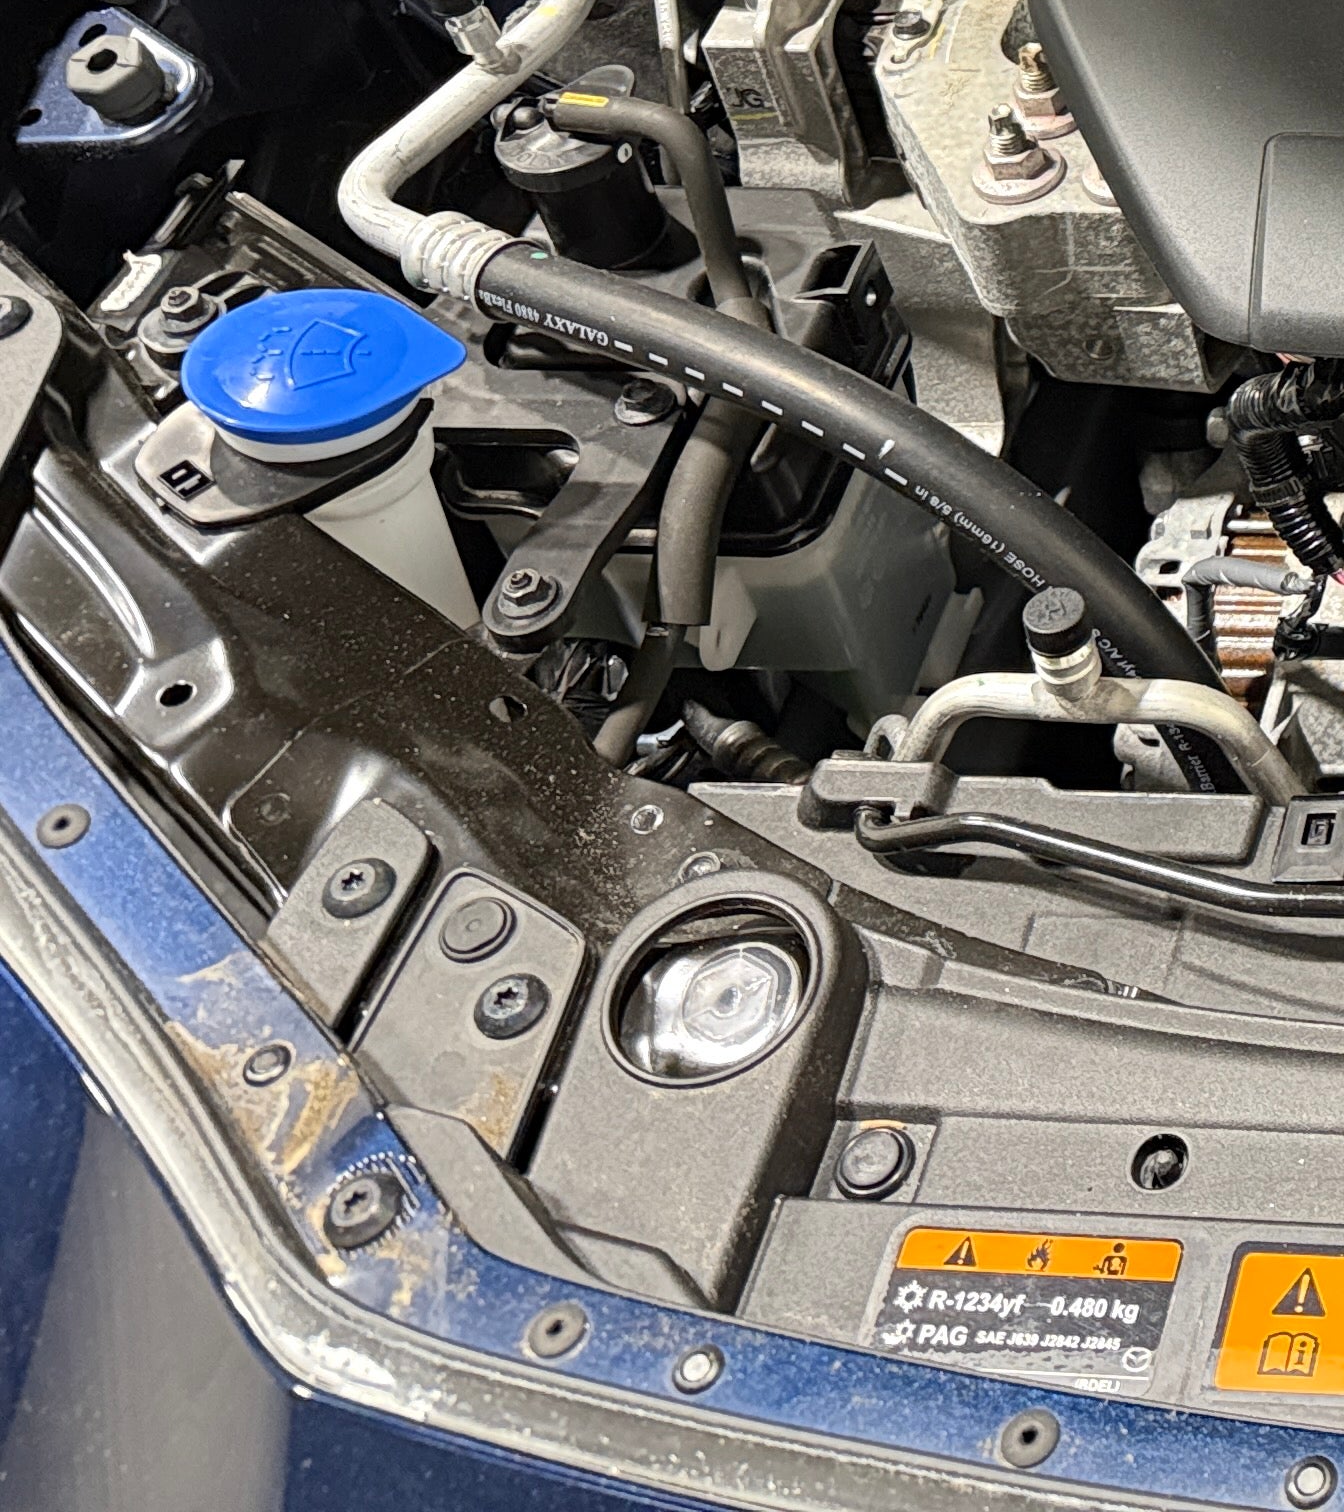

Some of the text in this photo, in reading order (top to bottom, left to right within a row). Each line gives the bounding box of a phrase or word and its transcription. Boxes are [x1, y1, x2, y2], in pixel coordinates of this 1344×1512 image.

[514, 302, 540, 324] 4880
[543, 312, 609, 347] GALAXY
[914, 485, 929, 500] in
[929, 495, 953, 516] 5/8
[953, 511, 1006, 554] (16mm)
[1003, 551, 1047, 588] HOSE
[928, 1291, 1140, 1325] R-1234yf 0.480 kg
[917, 1325, 969, 1346] PAG
[976, 1330, 1006, 1345] SAE
[1006, 1332, 1039, 1347] J639
[1040, 1333, 1080, 1349] J2842
